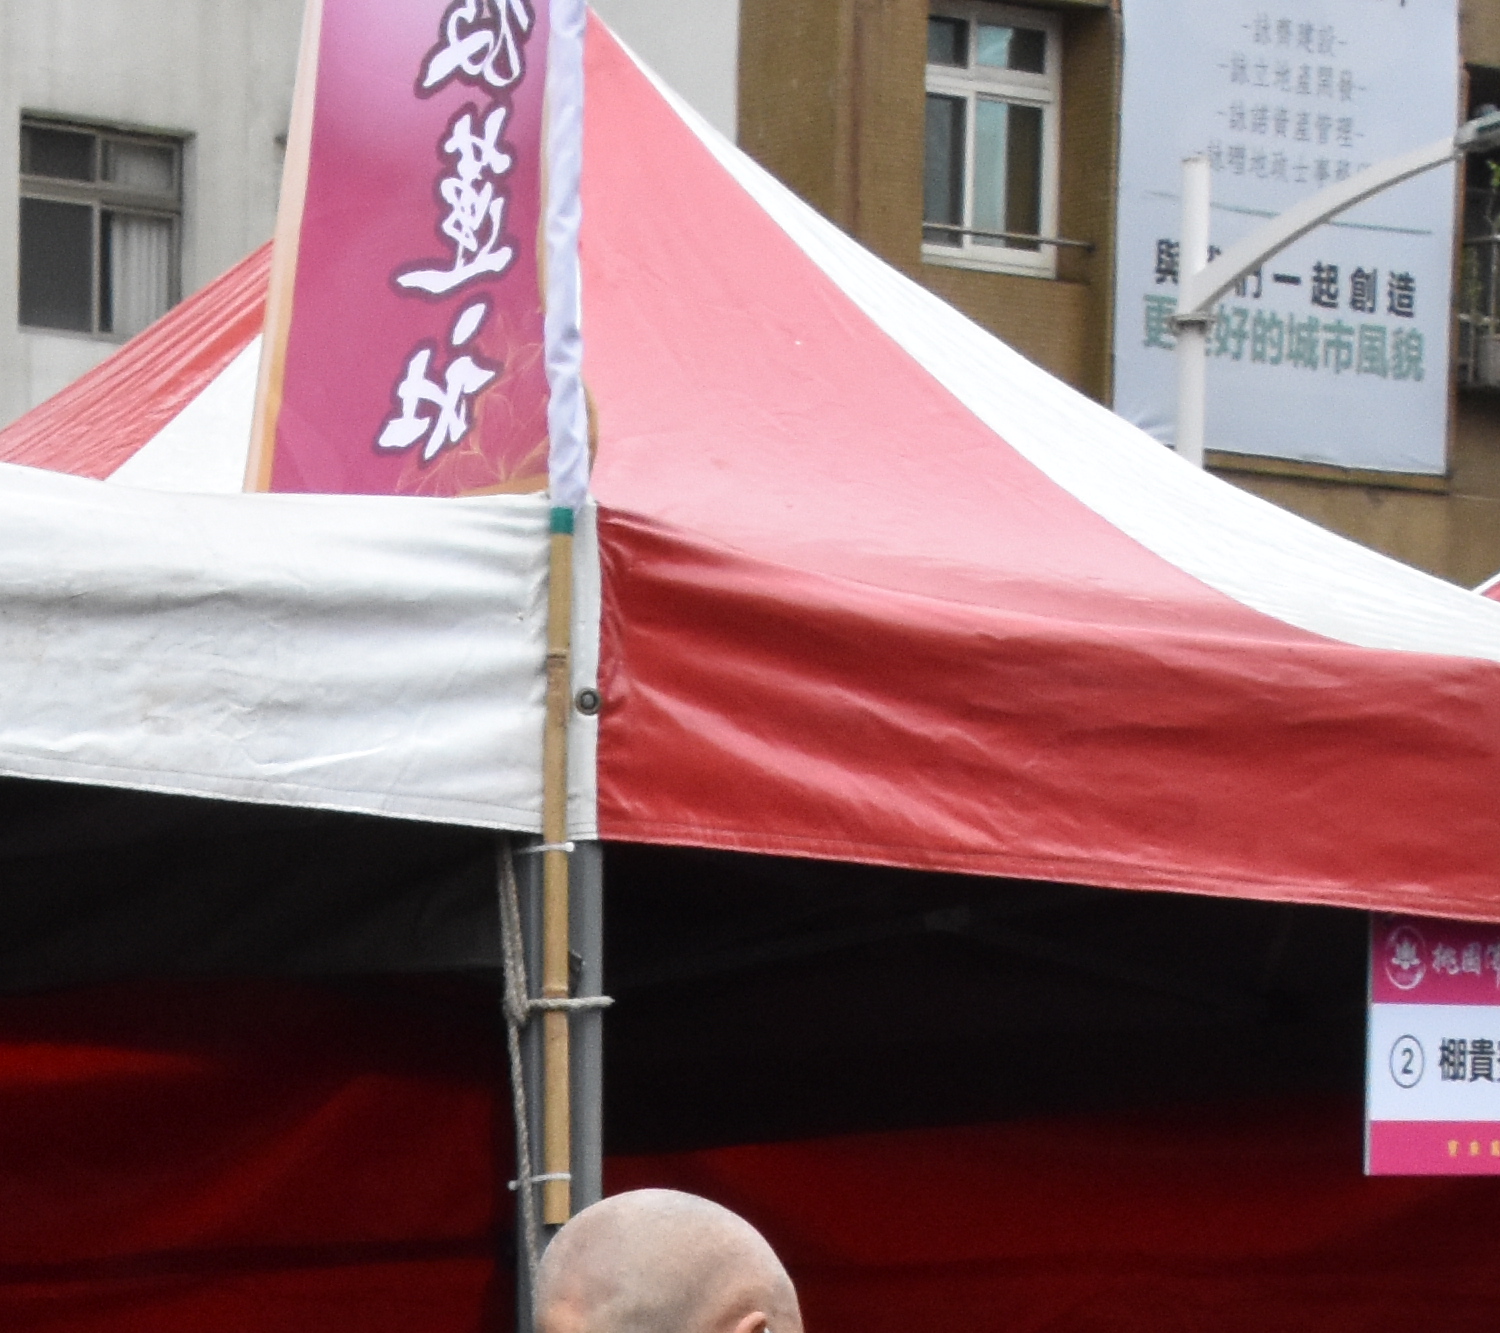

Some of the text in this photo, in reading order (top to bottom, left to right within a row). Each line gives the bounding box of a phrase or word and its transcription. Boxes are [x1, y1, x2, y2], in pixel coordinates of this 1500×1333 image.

[1156, 239, 1415, 318] 與一起創造
[1143, 293, 1424, 382] 更好的城市風貌
